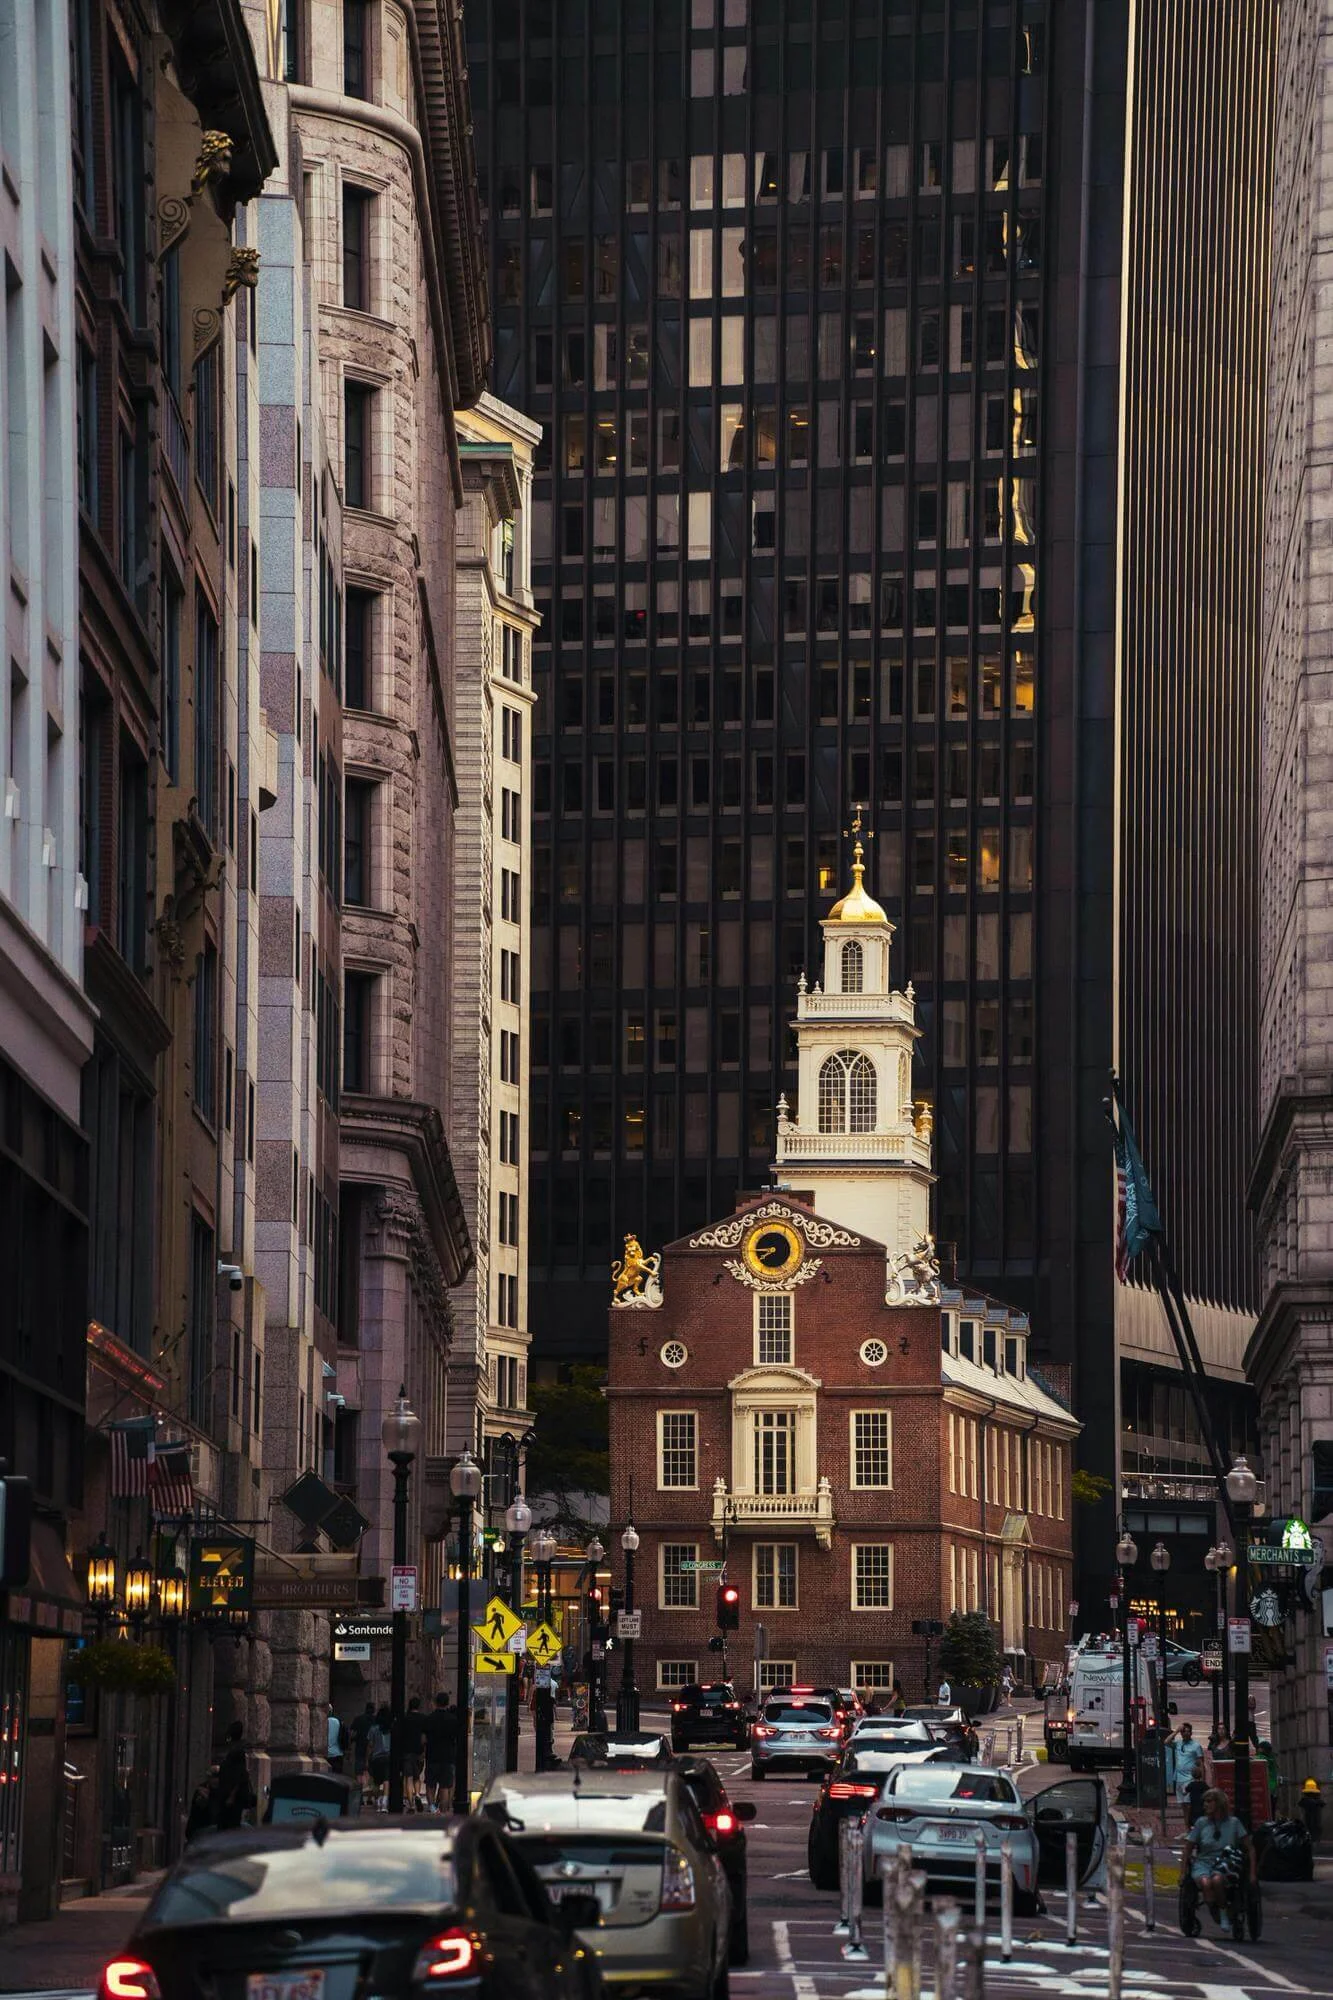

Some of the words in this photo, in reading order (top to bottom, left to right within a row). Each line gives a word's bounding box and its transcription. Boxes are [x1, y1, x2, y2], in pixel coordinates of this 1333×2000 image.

[1249, 1548, 1300, 1563] MERCHANTS
[281, 1582, 350, 1595] BROTHERS
[1083, 1673, 1107, 1682] New
